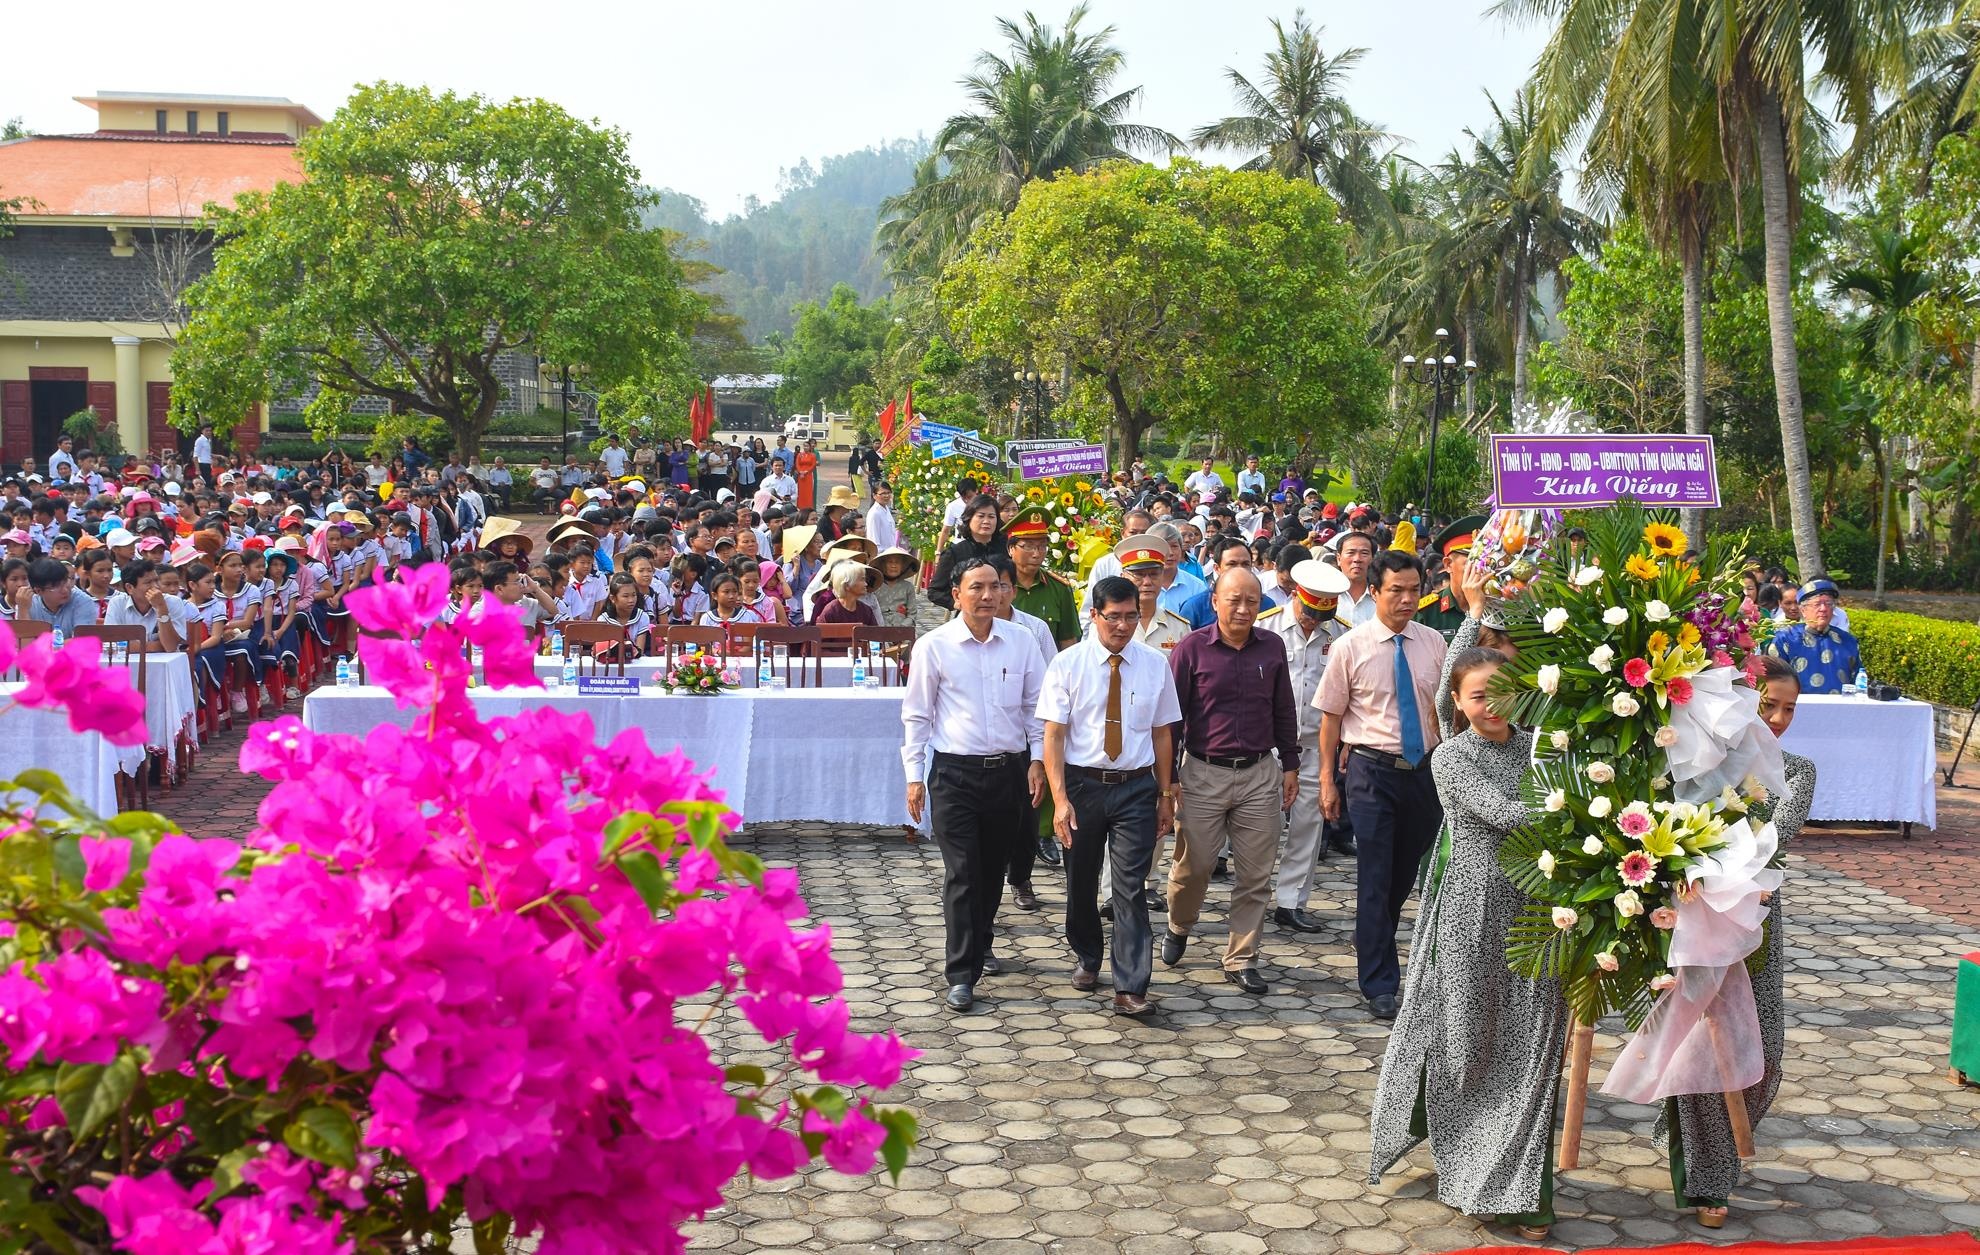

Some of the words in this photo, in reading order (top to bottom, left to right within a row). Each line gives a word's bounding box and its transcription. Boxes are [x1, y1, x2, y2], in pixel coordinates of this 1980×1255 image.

[1502, 446, 1520, 472] TỈNH
[1522, 446, 1532, 472] ỦY
[1540, 452, 1562, 472] HĐND
[1570, 452, 1592, 472] UBND
[1640, 446, 1659, 472] TỈNH
[1660, 446, 1686, 474] QUẢNG
[1687, 448, 1704, 472] NGÃI
[1532, 476, 1600, 496] Kính
[1605, 476, 1680, 498] Viếng
